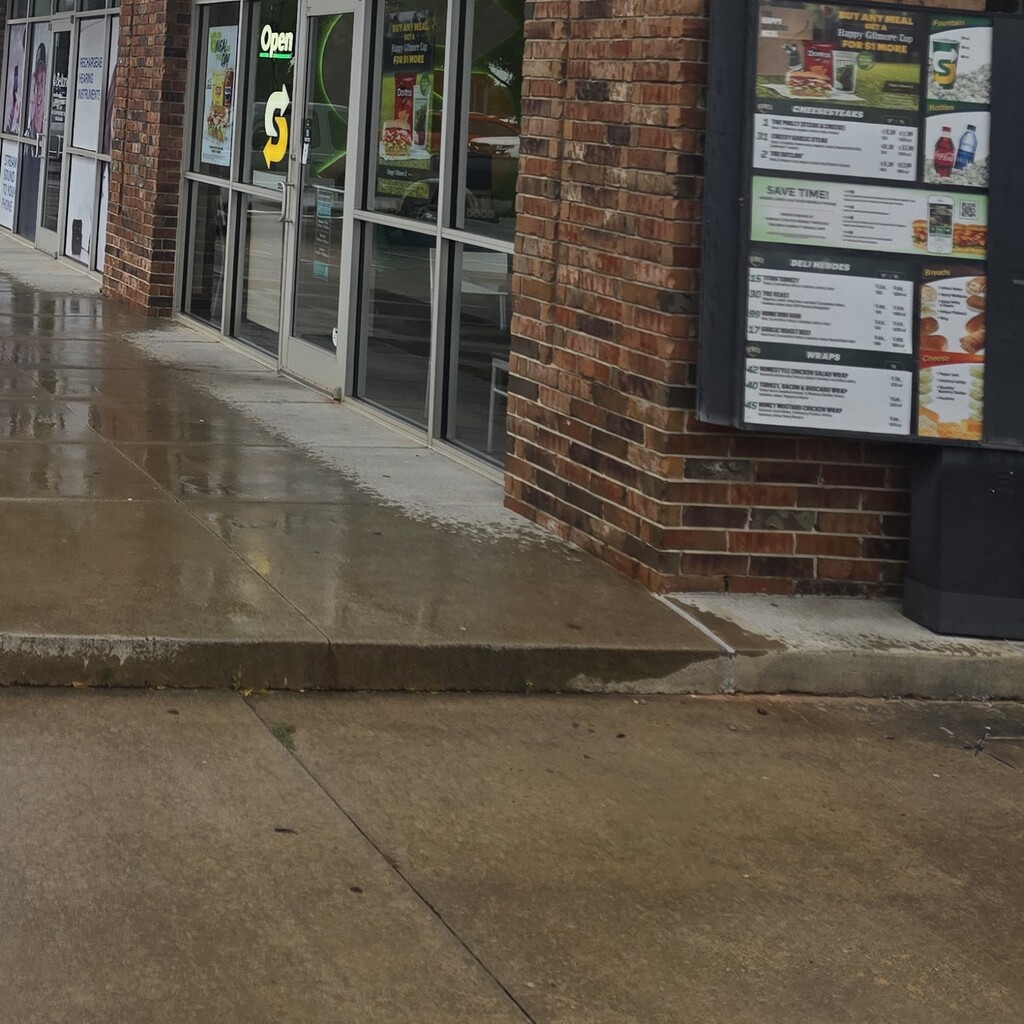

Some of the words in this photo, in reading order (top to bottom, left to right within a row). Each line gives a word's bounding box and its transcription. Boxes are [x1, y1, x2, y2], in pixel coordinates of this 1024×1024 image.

[837, 11, 860, 20] BUY
[861, 13, 883, 22] ANY
[885, 15, 914, 25] MEAL
[932, 19, 965, 27] Fountain
[392, 24, 404, 33] BUY
[837, 28, 863, 39] Happy
[865, 31, 898, 41] Gilmore
[260, 24, 294, 58] Open
[842, 40, 864, 49] FOR
[877, 43, 908, 54] MORE
[791, 105, 864, 119] CHEESESTEAKS
[766, 186, 795, 196] SAVE
[797, 188, 829, 199] TIME!
[790, 259, 812, 268] DELI
[813, 260, 851, 272] HEROES
[806, 351, 841, 362] WRAPS
